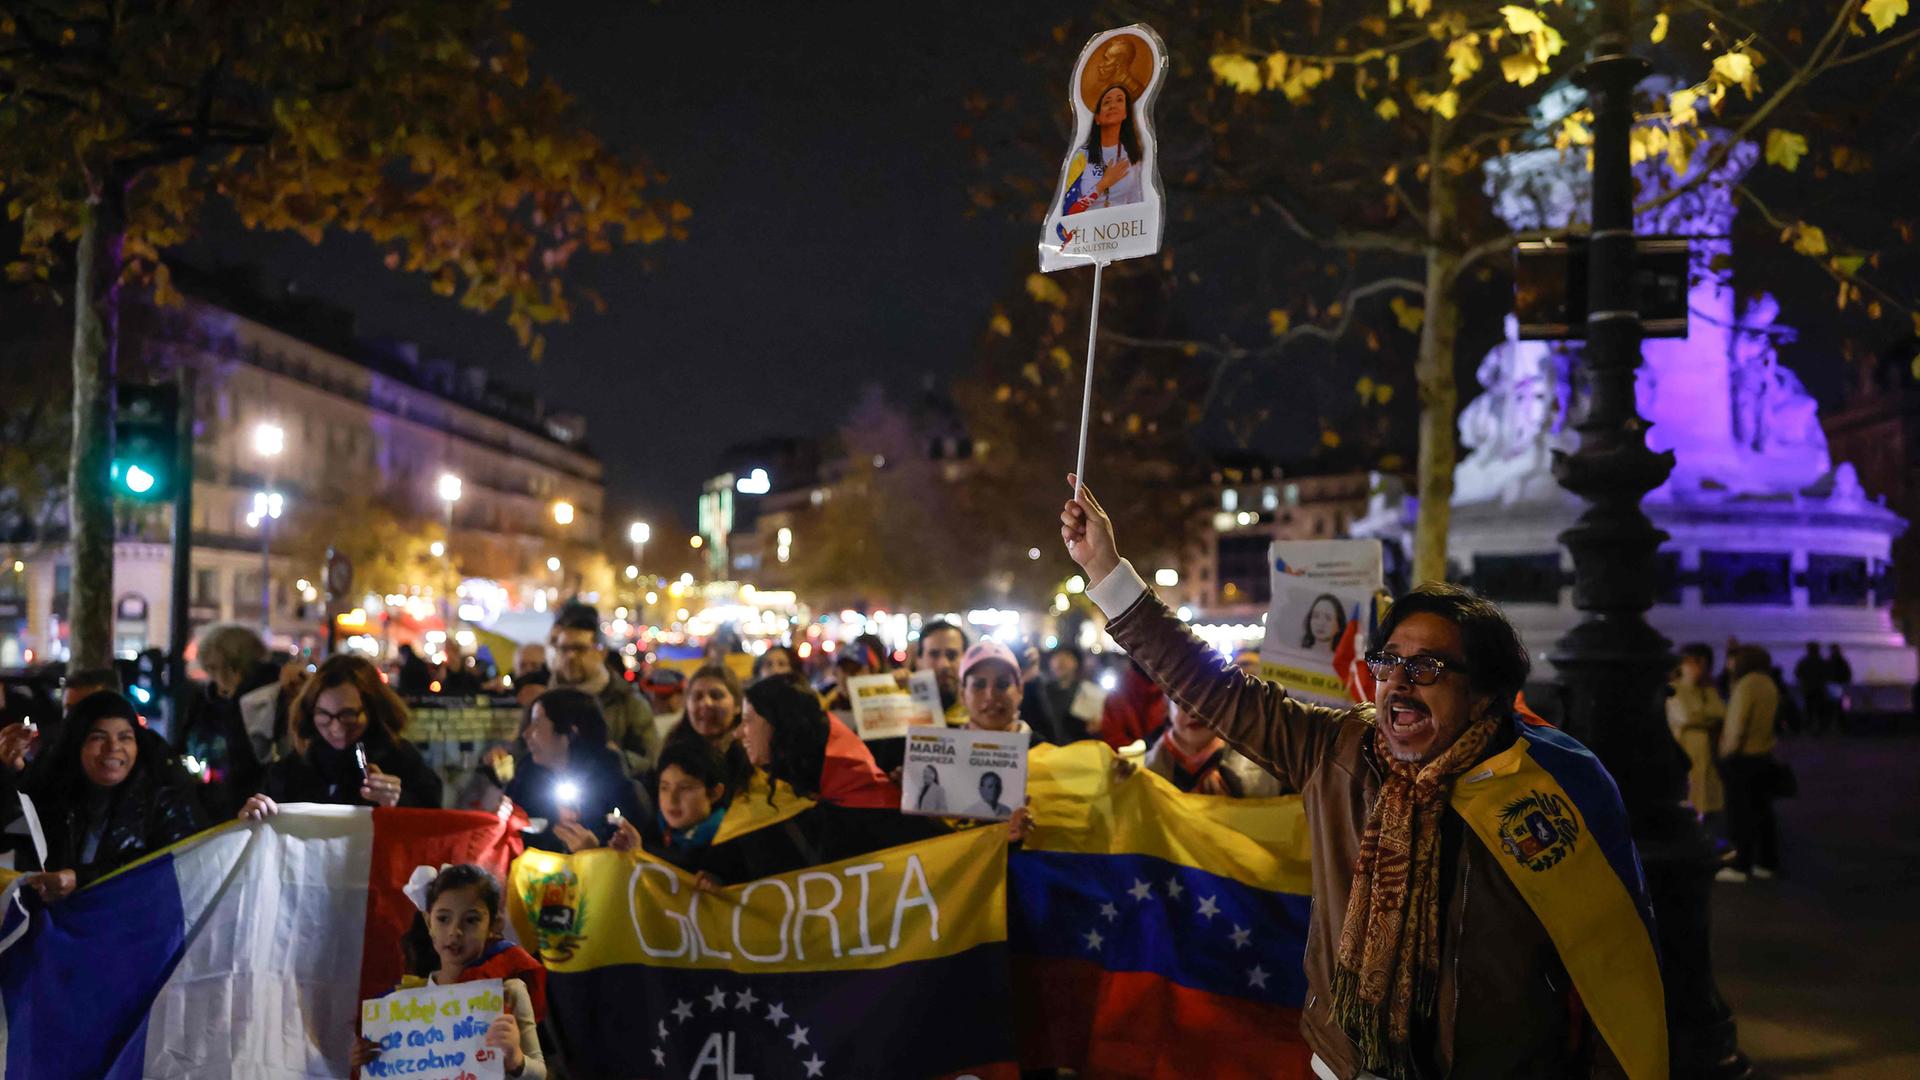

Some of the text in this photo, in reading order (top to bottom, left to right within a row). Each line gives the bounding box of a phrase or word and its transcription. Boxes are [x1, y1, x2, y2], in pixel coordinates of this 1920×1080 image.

[1075, 220, 1147, 244] EL NOBEL
[1082, 241, 1118, 253] NUESTRO
[910, 740, 956, 756] MARÍA
[629, 854, 940, 962] GLORIA
[380, 1031, 403, 1051] de
[407, 1025, 444, 1047] cada
[475, 1049, 495, 1062] en
[688, 1030, 754, 1080] AL
